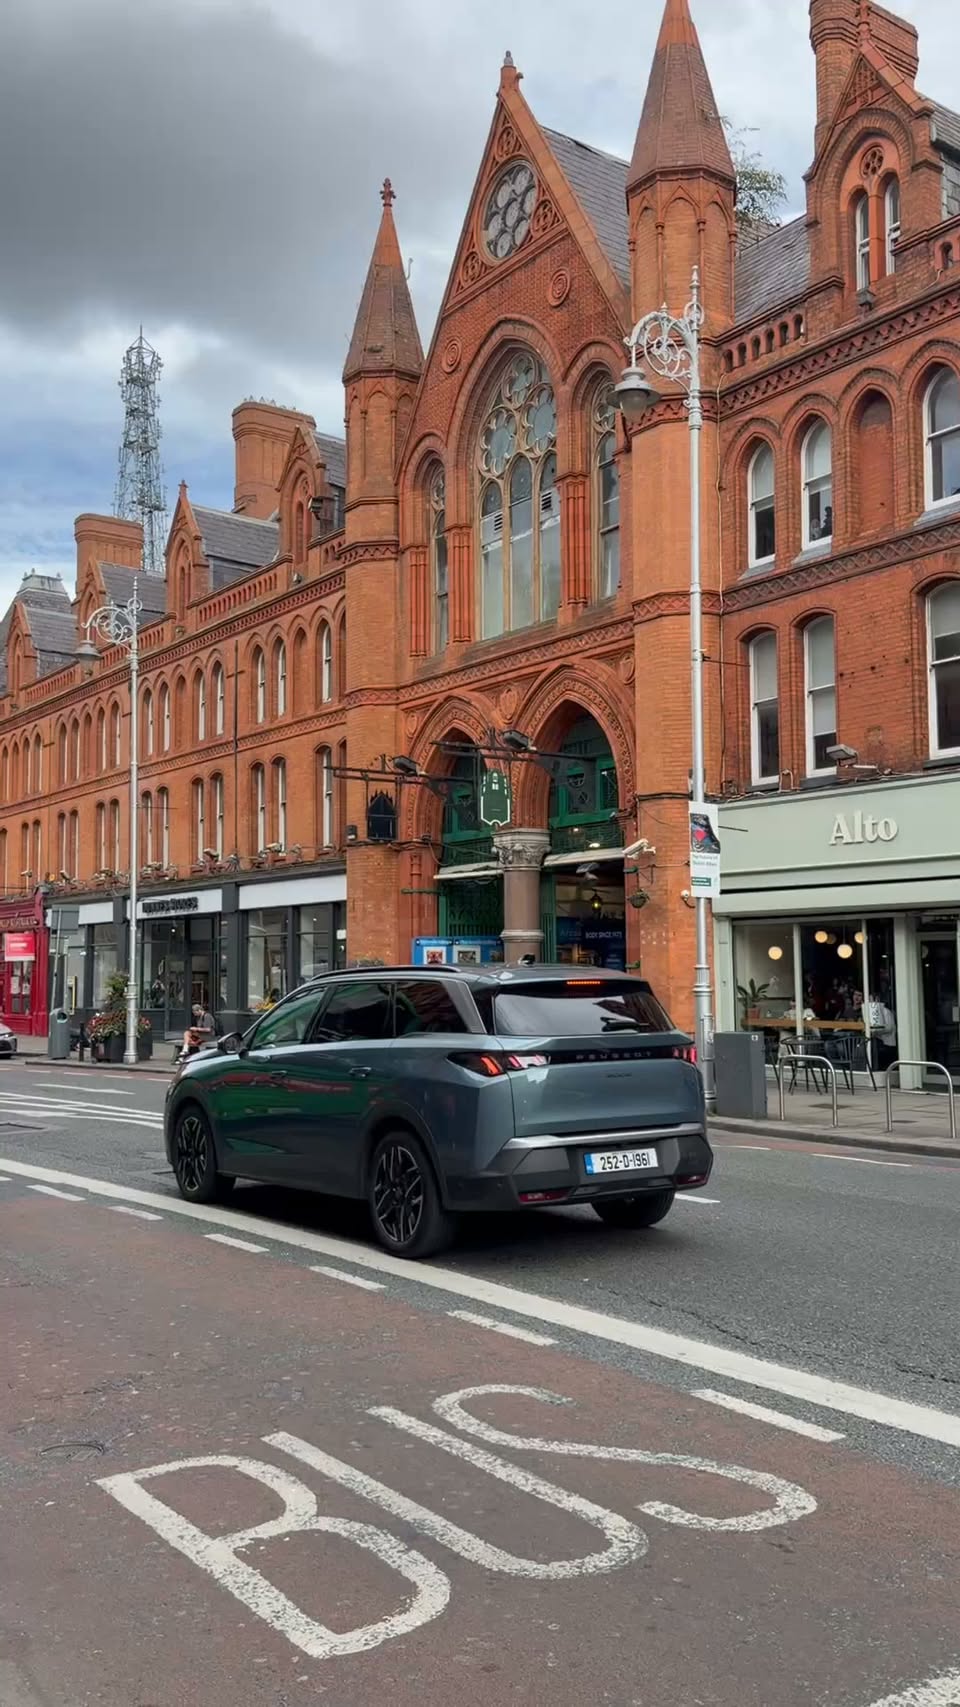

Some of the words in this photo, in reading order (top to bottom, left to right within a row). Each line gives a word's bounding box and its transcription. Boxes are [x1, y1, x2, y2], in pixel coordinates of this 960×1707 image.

[829, 810, 898, 845] Alto
[576, 1051, 652, 1060] PEUGEOT
[600, 1152, 651, 1171] 252-D-1961
[94, 1383, 817, 1659] BUS
